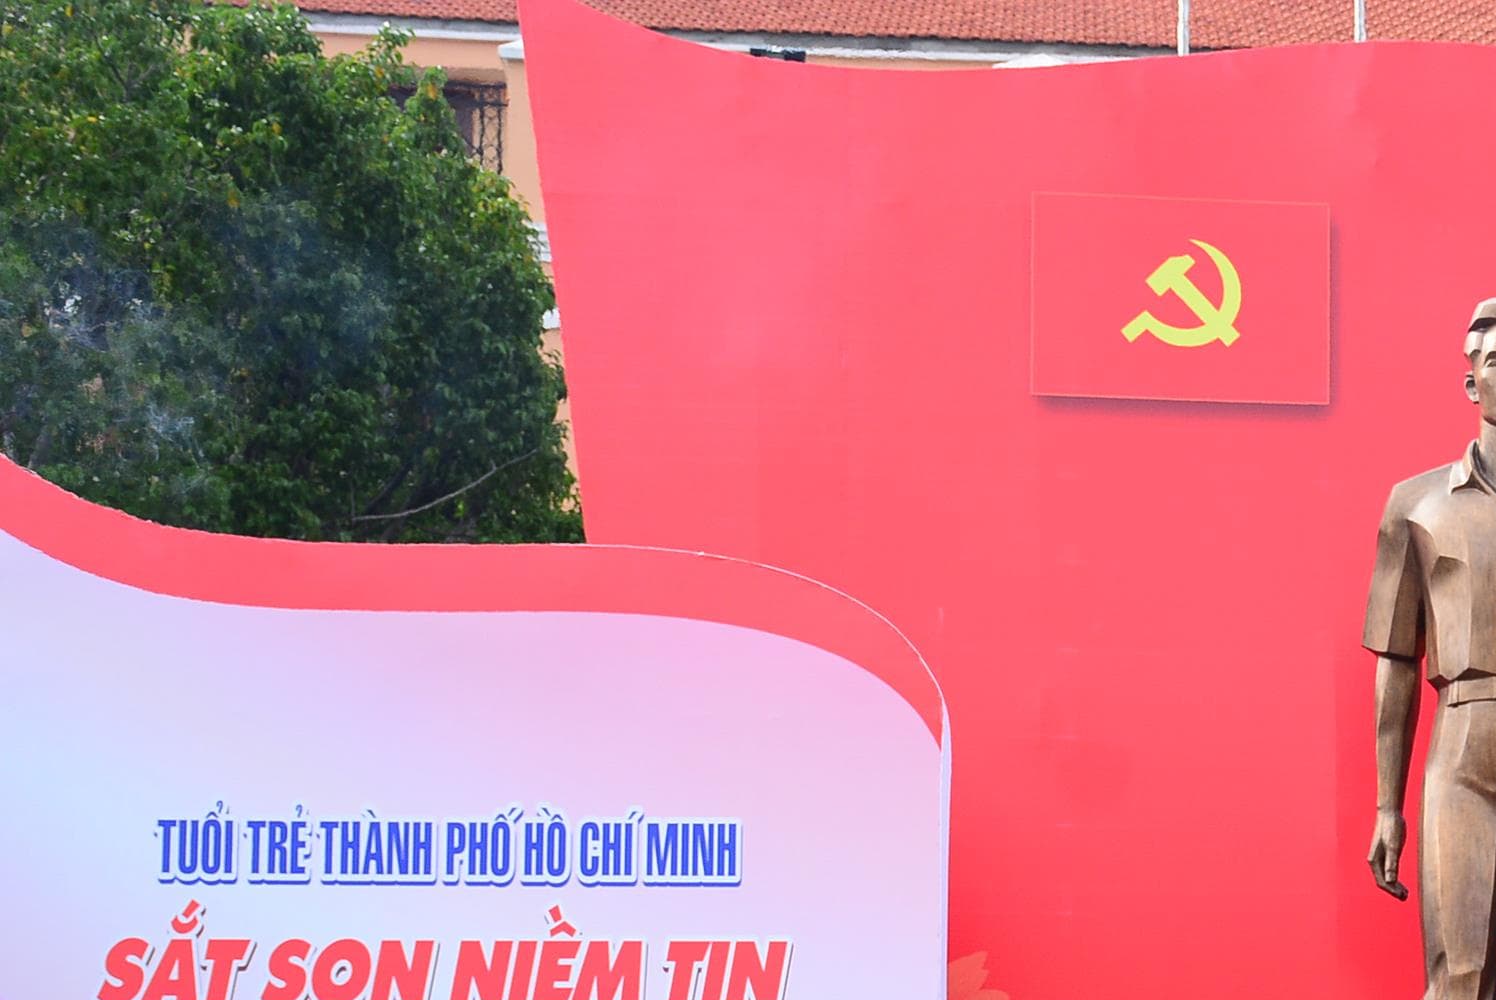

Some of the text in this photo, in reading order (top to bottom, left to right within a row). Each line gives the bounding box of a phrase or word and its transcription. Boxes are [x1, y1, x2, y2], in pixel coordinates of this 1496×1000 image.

[157, 800, 740, 885] TUỔI TRẺ THÀNH PHỐ HỒ CHÍ MINH
